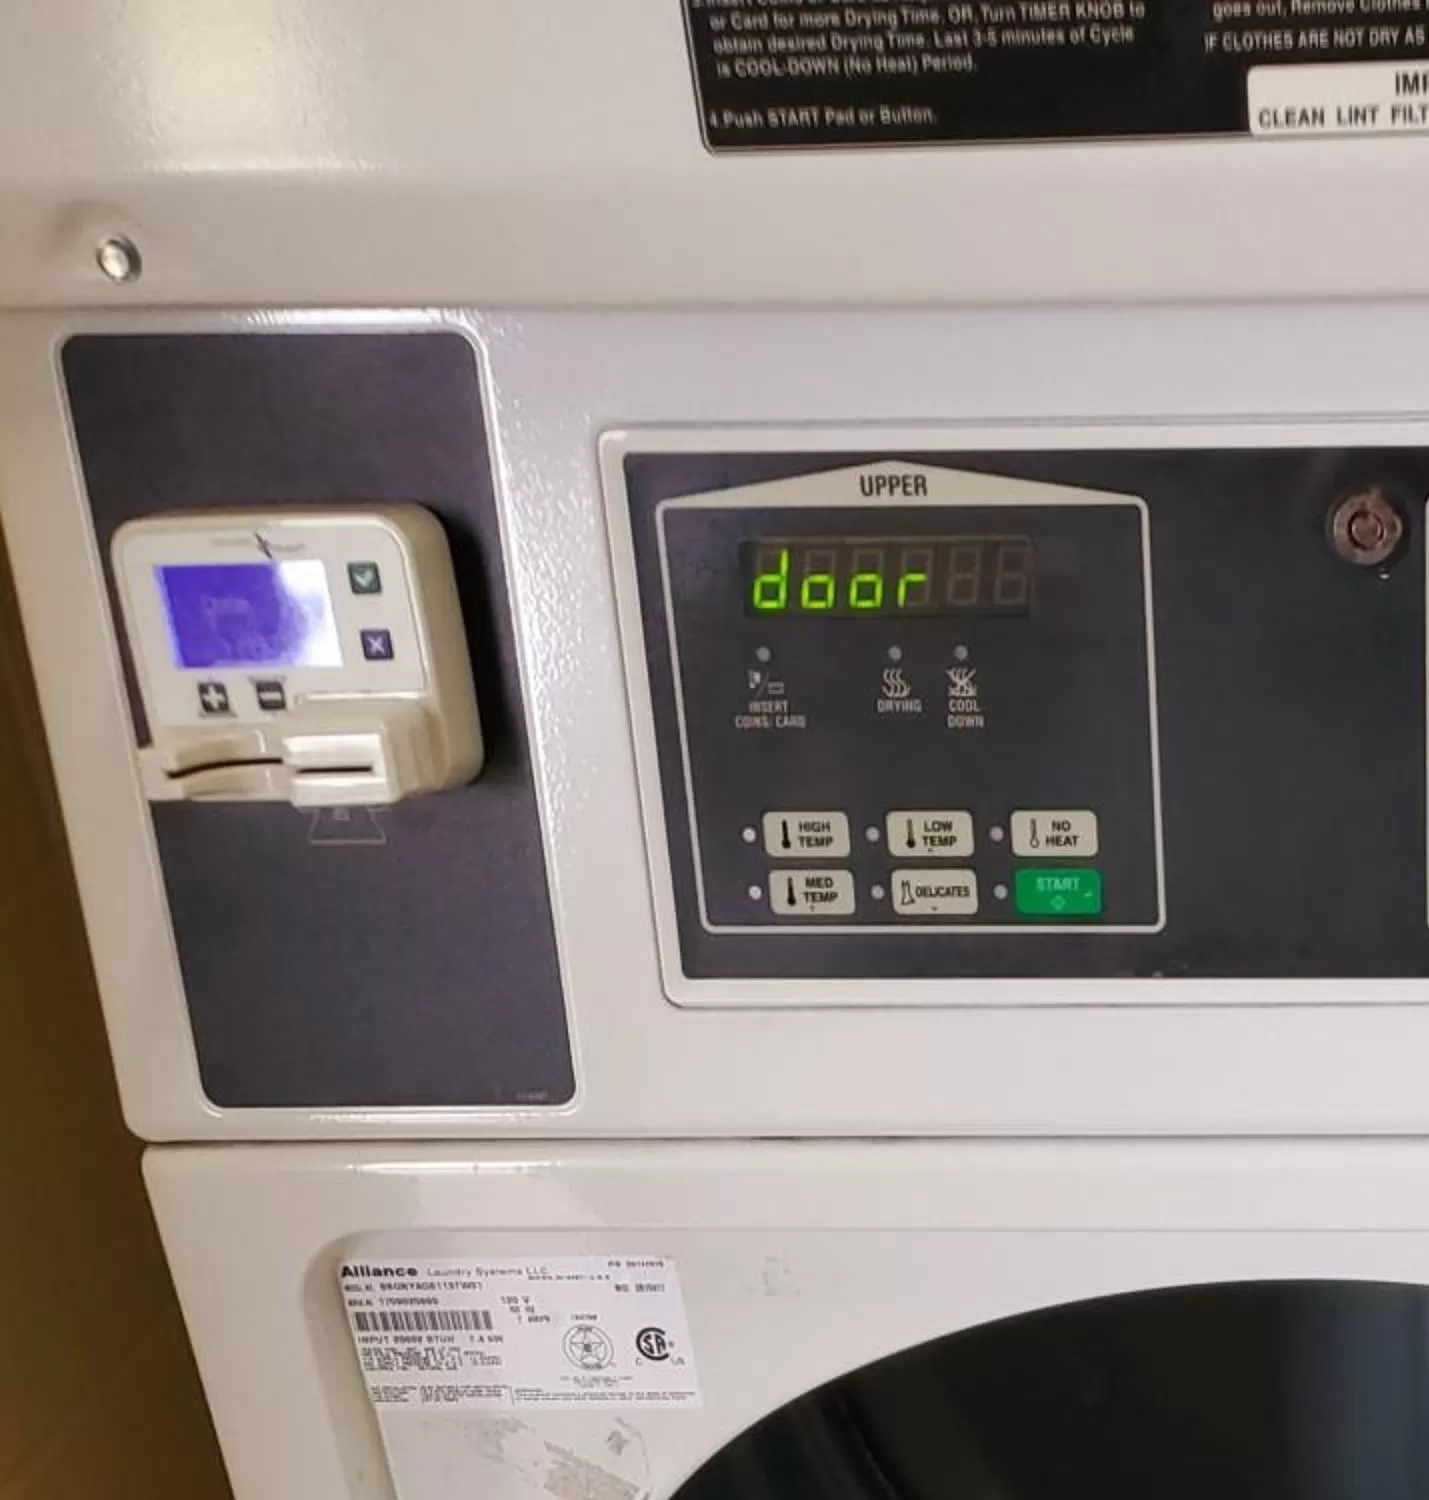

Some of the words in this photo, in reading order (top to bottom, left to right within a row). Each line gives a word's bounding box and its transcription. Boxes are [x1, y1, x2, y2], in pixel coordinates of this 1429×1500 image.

[709, 14, 726, 31] or
[730, 10, 769, 31] Card
[772, 10, 795, 30] for
[799, 11, 841, 29] more
[844, 7, 898, 30] Drying
[979, 3, 1016, 23] Turn
[1019, 1, 1071, 22] TIMER
[1075, 0, 1125, 20] KNOB
[1129, 1, 1145, 19] to
[712, 35, 764, 54] obtain
[767, 33, 826, 53] desired
[830, 31, 884, 54] Drying
[932, 28, 969, 48] Last
[1001, 26, 1066, 47] minutes
[1069, 26, 1085, 45] of
[1089, 23, 1136, 47] Cycle
[1203, 31, 1218, 52] IF
[1222, 30, 1293, 51] CLOTHES
[1299, 27, 1329, 49] ARE
[1333, 26, 1365, 48] NOT
[1369, 25, 1400, 47] DRY
[1404, 24, 1425, 45] AS
[716, 62, 731, 79] is
[843, 55, 872, 79] (No
[875, 53, 918, 76] Heat)
[767, 106, 820, 128] START
[823, 104, 856, 127] Pad
[859, 108, 876, 126] or
[1258, 104, 1326, 128] CLEAN
[1336, 103, 1380, 125] LINT
[859, 474, 929, 498] UPPER
[751, 546, 928, 610] door
[748, 700, 789, 713] INSERT
[876, 700, 923, 713] DRYING
[949, 700, 981, 713] COOL
[775, 715, 806, 729] CARD
[947, 715, 985, 728] DOWN
[798, 821, 832, 834] HIGH
[923, 821, 954, 834] LOW
[1050, 820, 1072, 833] NO
[796, 835, 834, 848] TEMP
[921, 835, 959, 847] TEMP
[1045, 835, 1080, 848] HEAT
[804, 877, 835, 890] MED
[1035, 877, 1081, 893] START
[803, 891, 839, 904] TEMP
[915, 885, 971, 900] DELICATES
[341, 1264, 419, 1279] Alliance
[426, 1267, 472, 1278] Laundry
[475, 1266, 523, 1278] Systems
